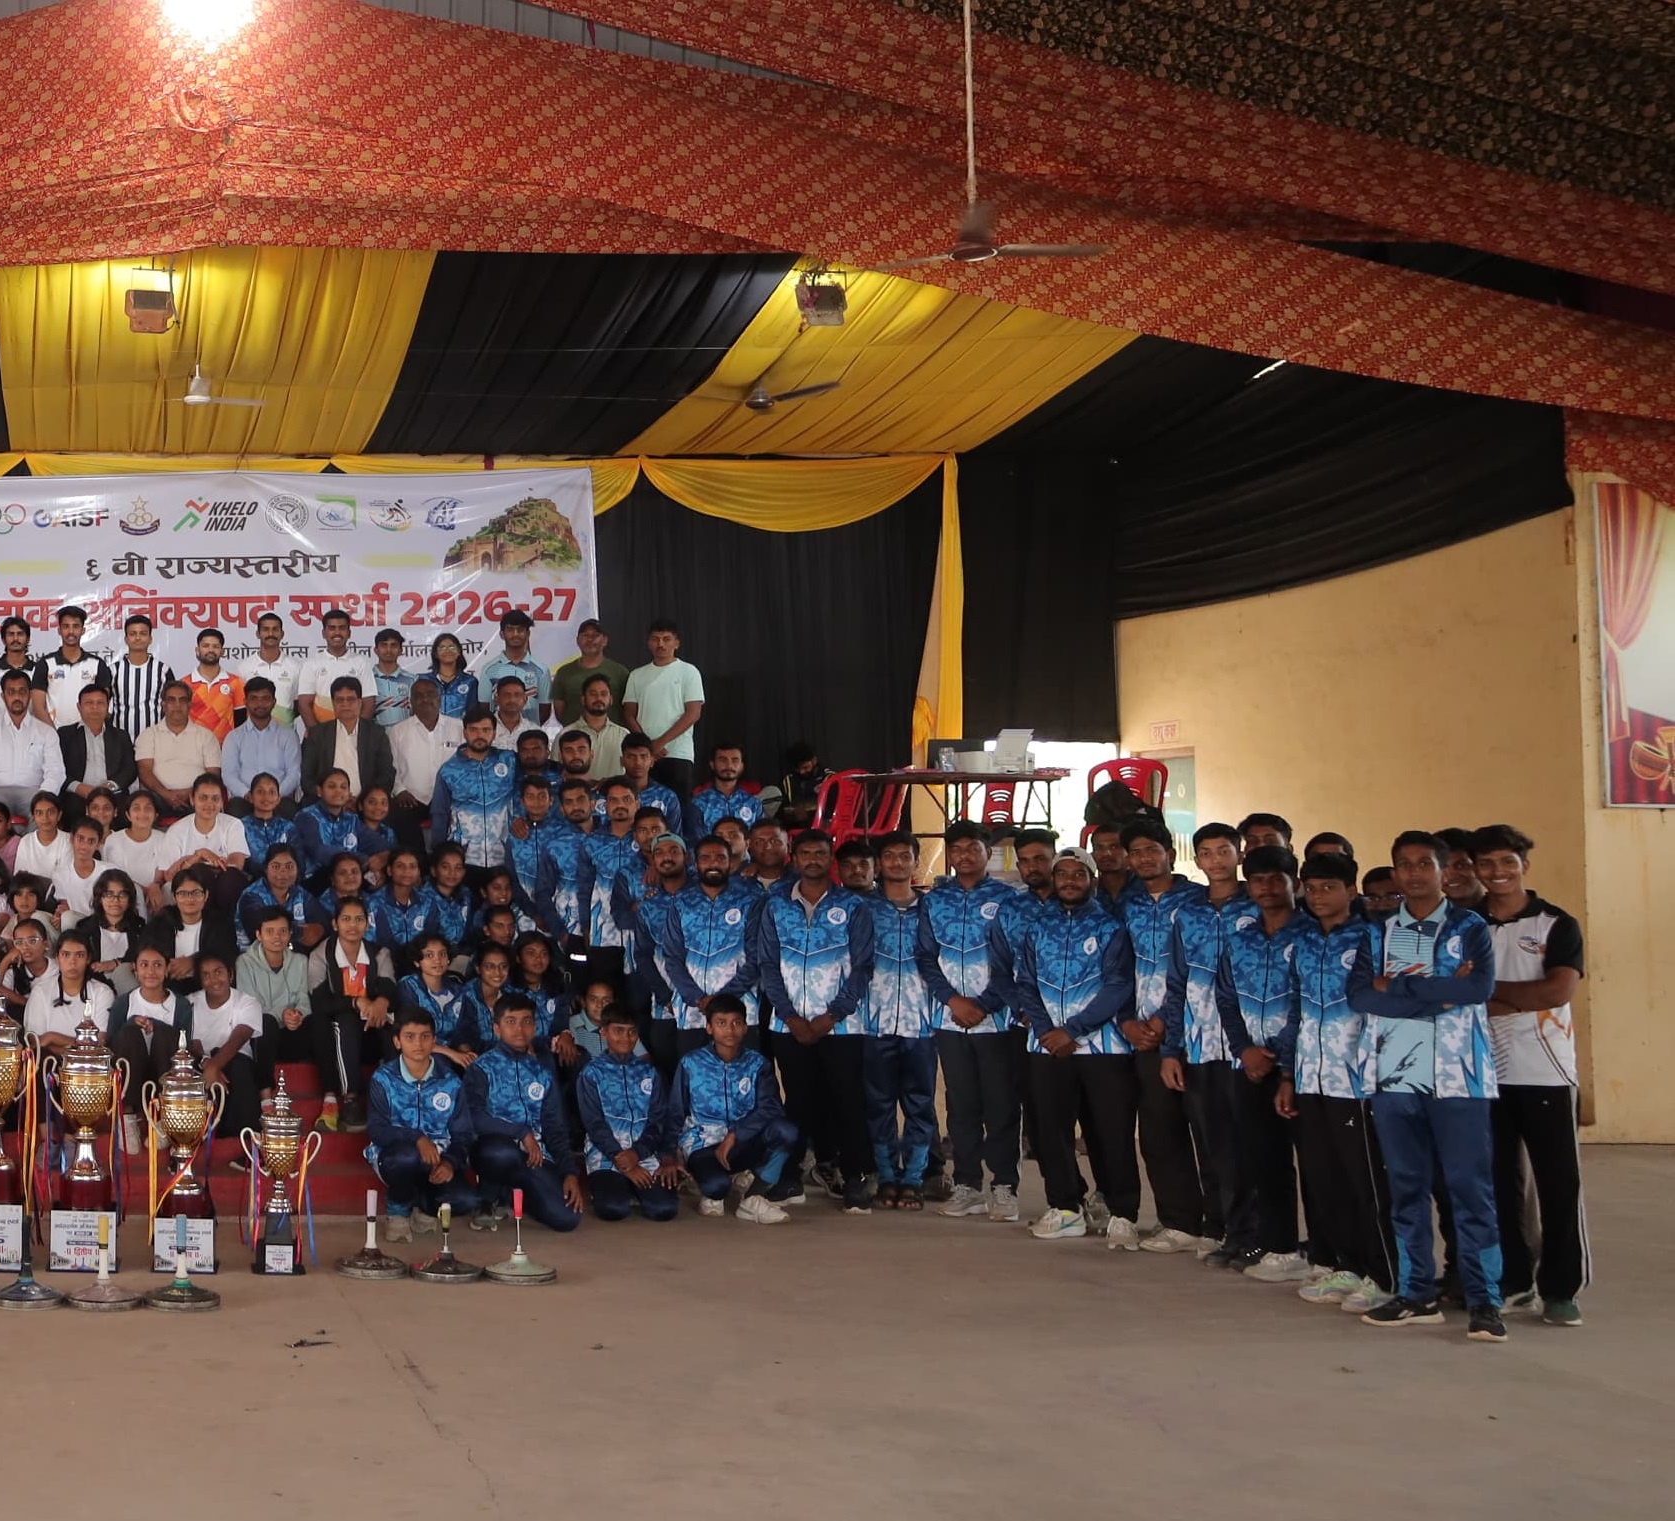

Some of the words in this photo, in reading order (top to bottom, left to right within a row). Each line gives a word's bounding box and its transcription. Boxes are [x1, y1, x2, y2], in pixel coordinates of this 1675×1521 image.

[208, 501, 259, 516] KHELO
[204, 517, 247, 532] INDIA
[112, 552, 149, 576] वी
[155, 549, 340, 580] राज्यस्तरीय
[400, 587, 576, 626] 2026-27
